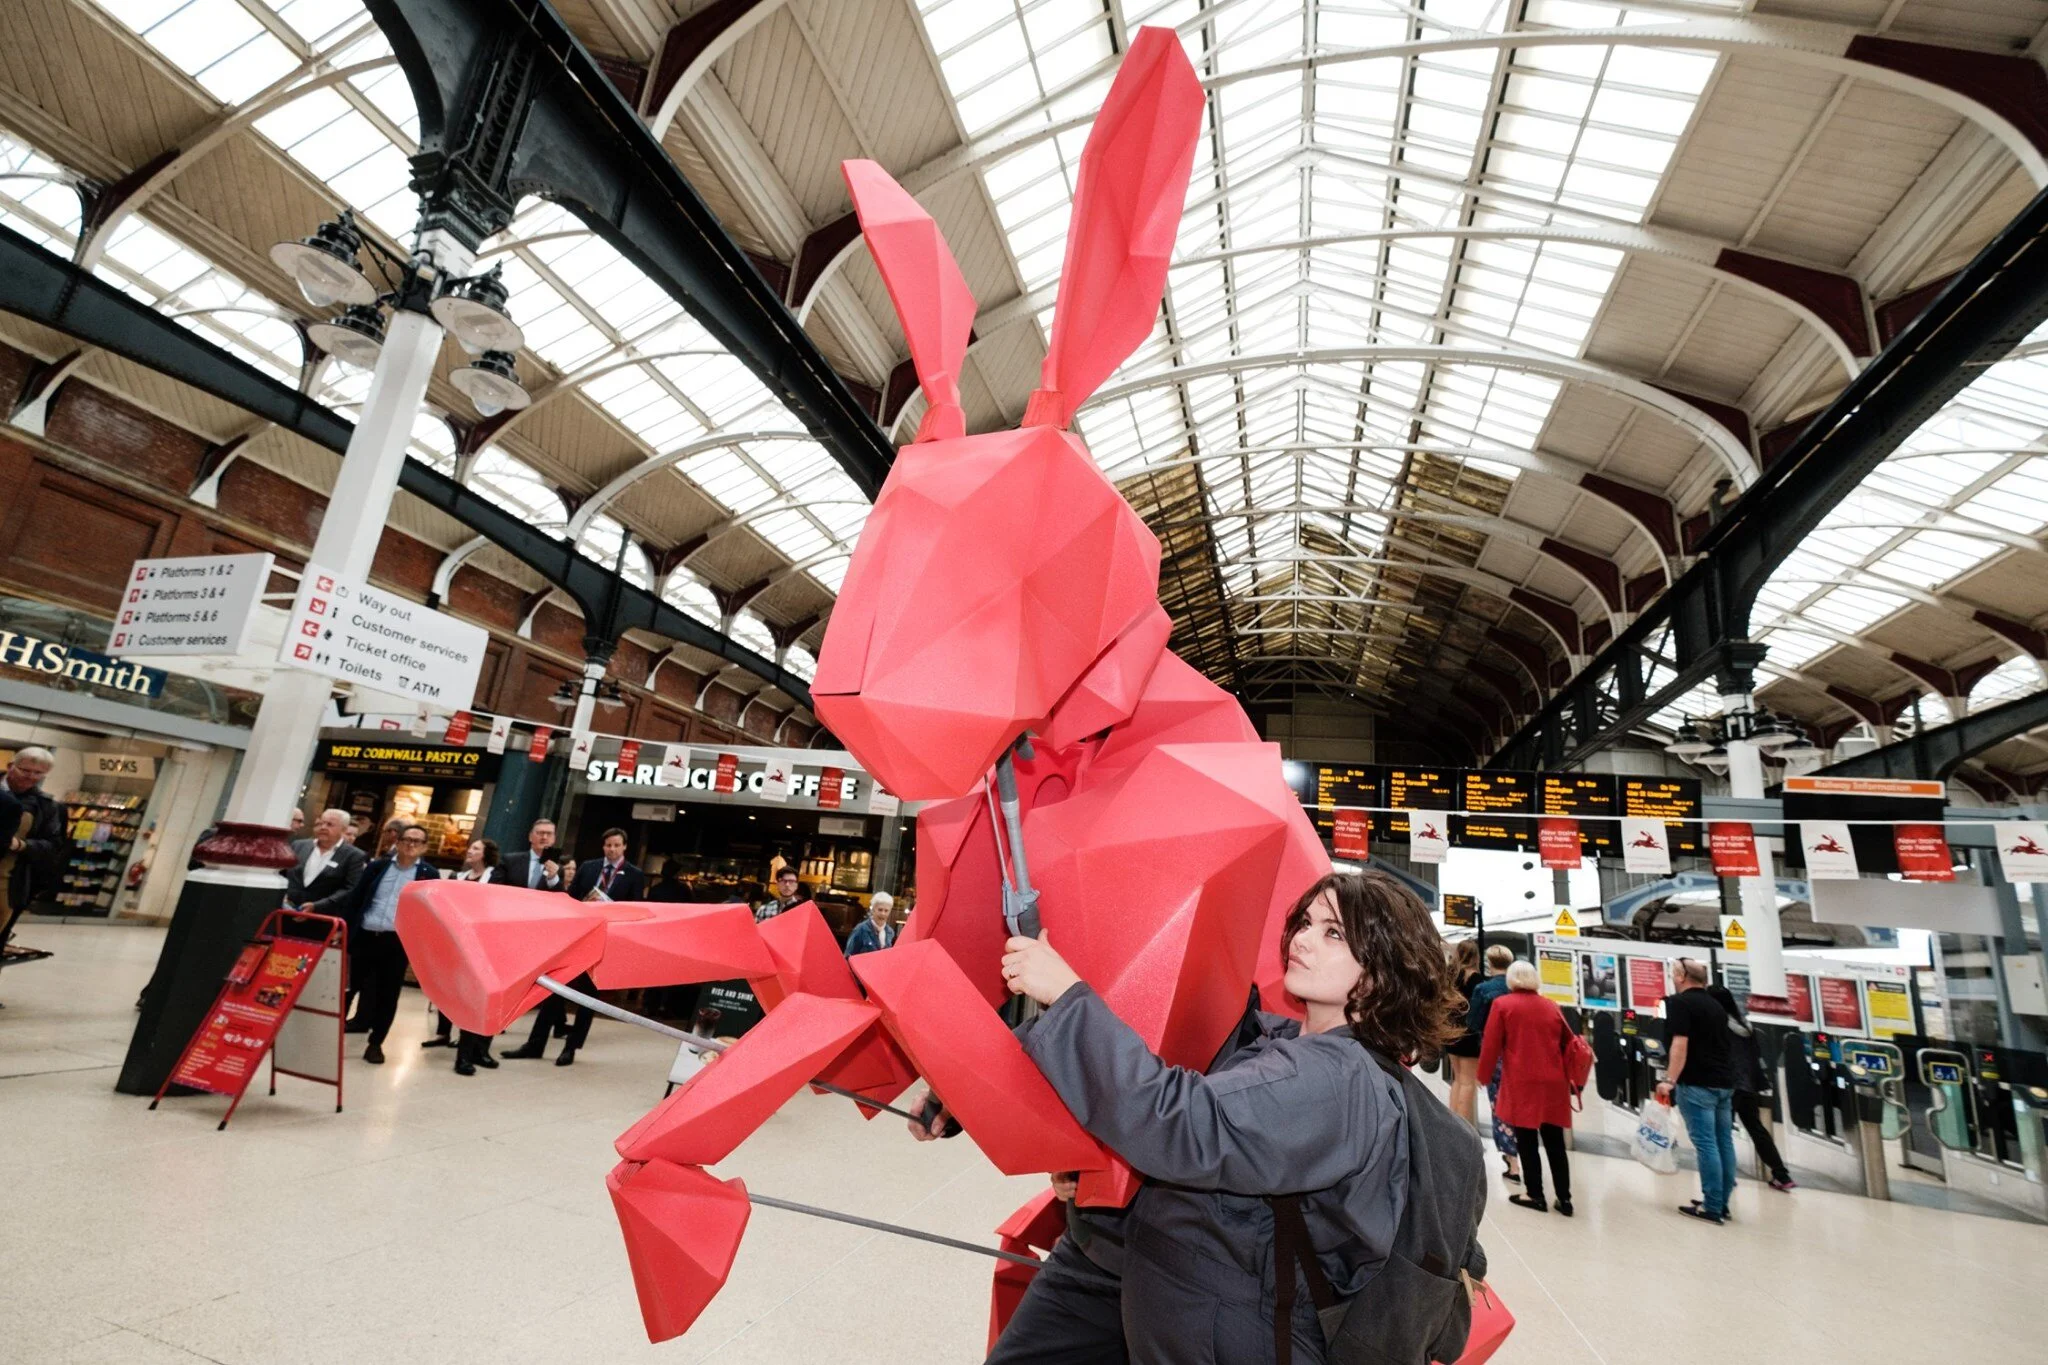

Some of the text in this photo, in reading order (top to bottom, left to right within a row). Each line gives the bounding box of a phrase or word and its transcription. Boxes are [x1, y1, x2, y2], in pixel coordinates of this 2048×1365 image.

[160, 565, 206, 579] Platforms
[215, 565, 225, 576] &
[225, 564, 234, 575] 2
[152, 587, 226, 602] Platforms 3 & 4
[358, 592, 412, 623] Way out
[145, 610, 218, 625] Platforms 5 & 6
[138, 634, 228, 647] Customer services
[352, 615, 469, 665] Customer services
[346, 636, 427, 672] Ticket office
[338, 658, 440, 698] Toilets ATM
[332, 745, 360, 758] WEST
[363, 747, 423, 762] CORNWALL
[425, 750, 462, 764] PASTY
[99, 758, 138, 774] BOOKS
[586, 760, 743, 793] STRCS
[748, 771, 857, 800] CFFE
[1814, 780, 1912, 792] Railway Information
[725, 989, 737, 998] AND
